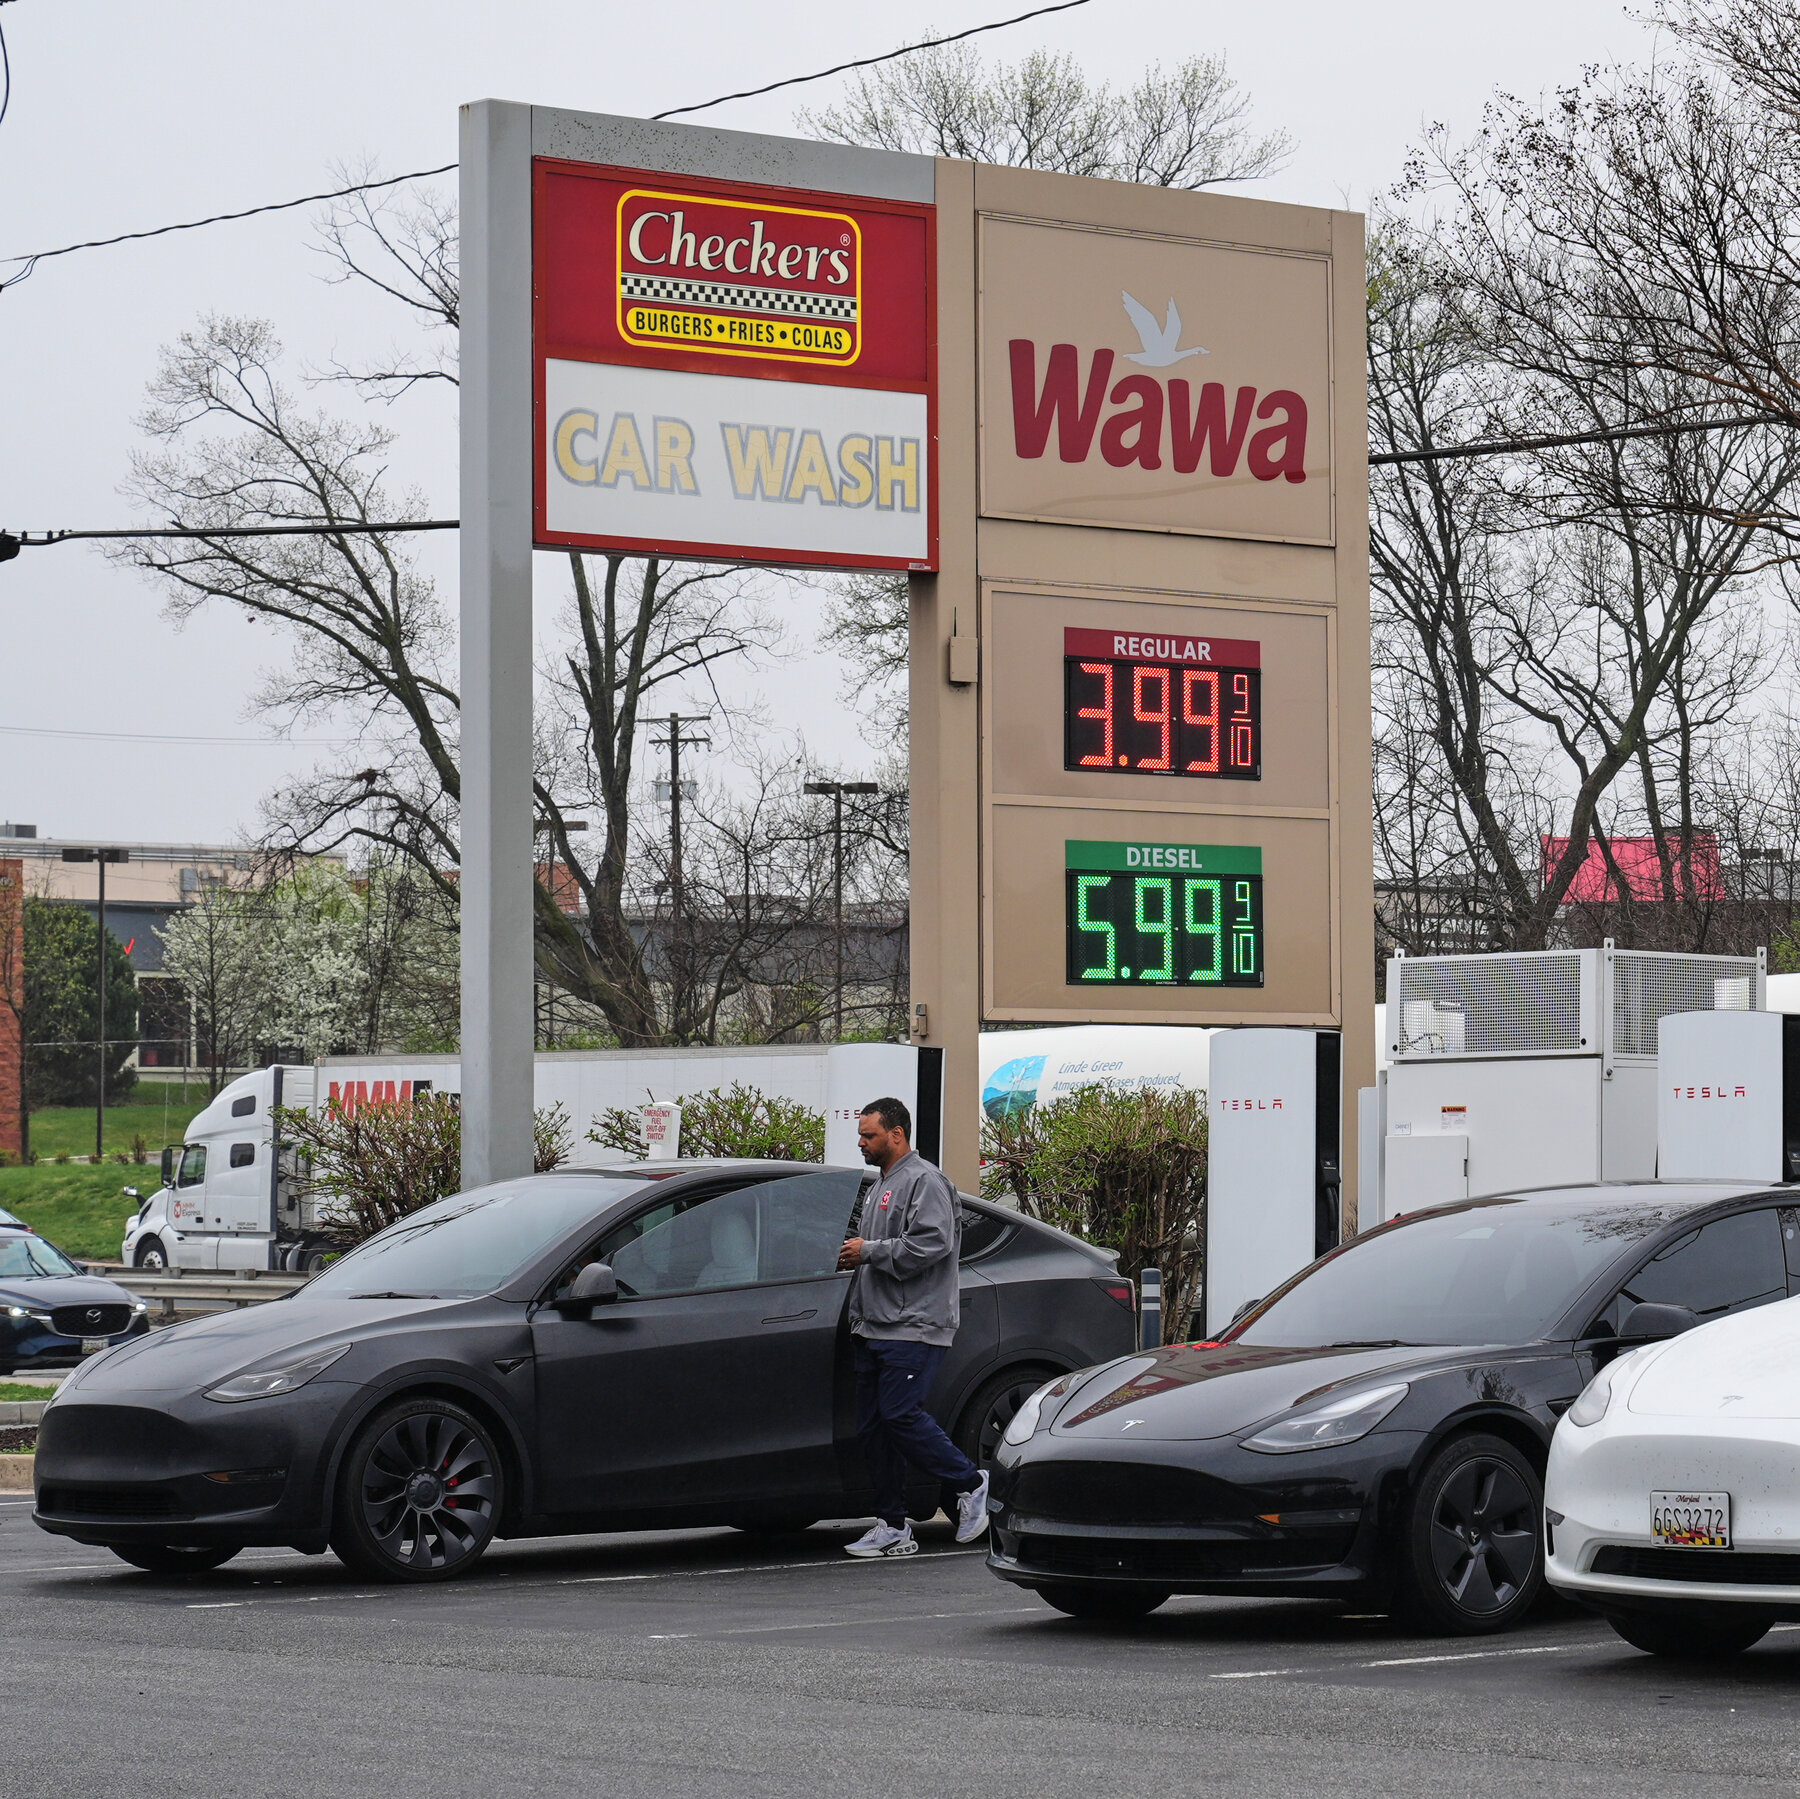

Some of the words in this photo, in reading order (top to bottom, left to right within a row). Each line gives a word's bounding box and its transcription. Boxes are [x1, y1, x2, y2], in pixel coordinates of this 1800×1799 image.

[629, 211, 850, 285] Checkers
[636, 312, 712, 337] BURGERS
[729, 321, 774, 343] FRIES
[792, 327, 843, 350] COLAS
[1009, 339, 1308, 484] Wawa
[552, 407, 701, 498] CAR
[719, 422, 921, 513] WASH
[1113, 635, 1212, 661] REGULAR
[1077, 662, 1219, 772] 3.99
[1126, 847, 1203, 868] DIESEL
[1077, 876, 1222, 980] 5.99
[1058, 1060, 1089, 1074] Linde
[1091, 1060, 1124, 1073] Green
[1137, 1072, 1181, 1086] Produced
[1673, 1086, 1745, 1099] TESLA
[644, 1109, 670, 1117] EMERGENCY
[1221, 1099, 1283, 1111] TESLA
[652, 1117, 662, 1125] FUEL
[1675, 1494, 1700, 1505] Maryland
[1654, 1507, 1724, 1539] 6GS3272
